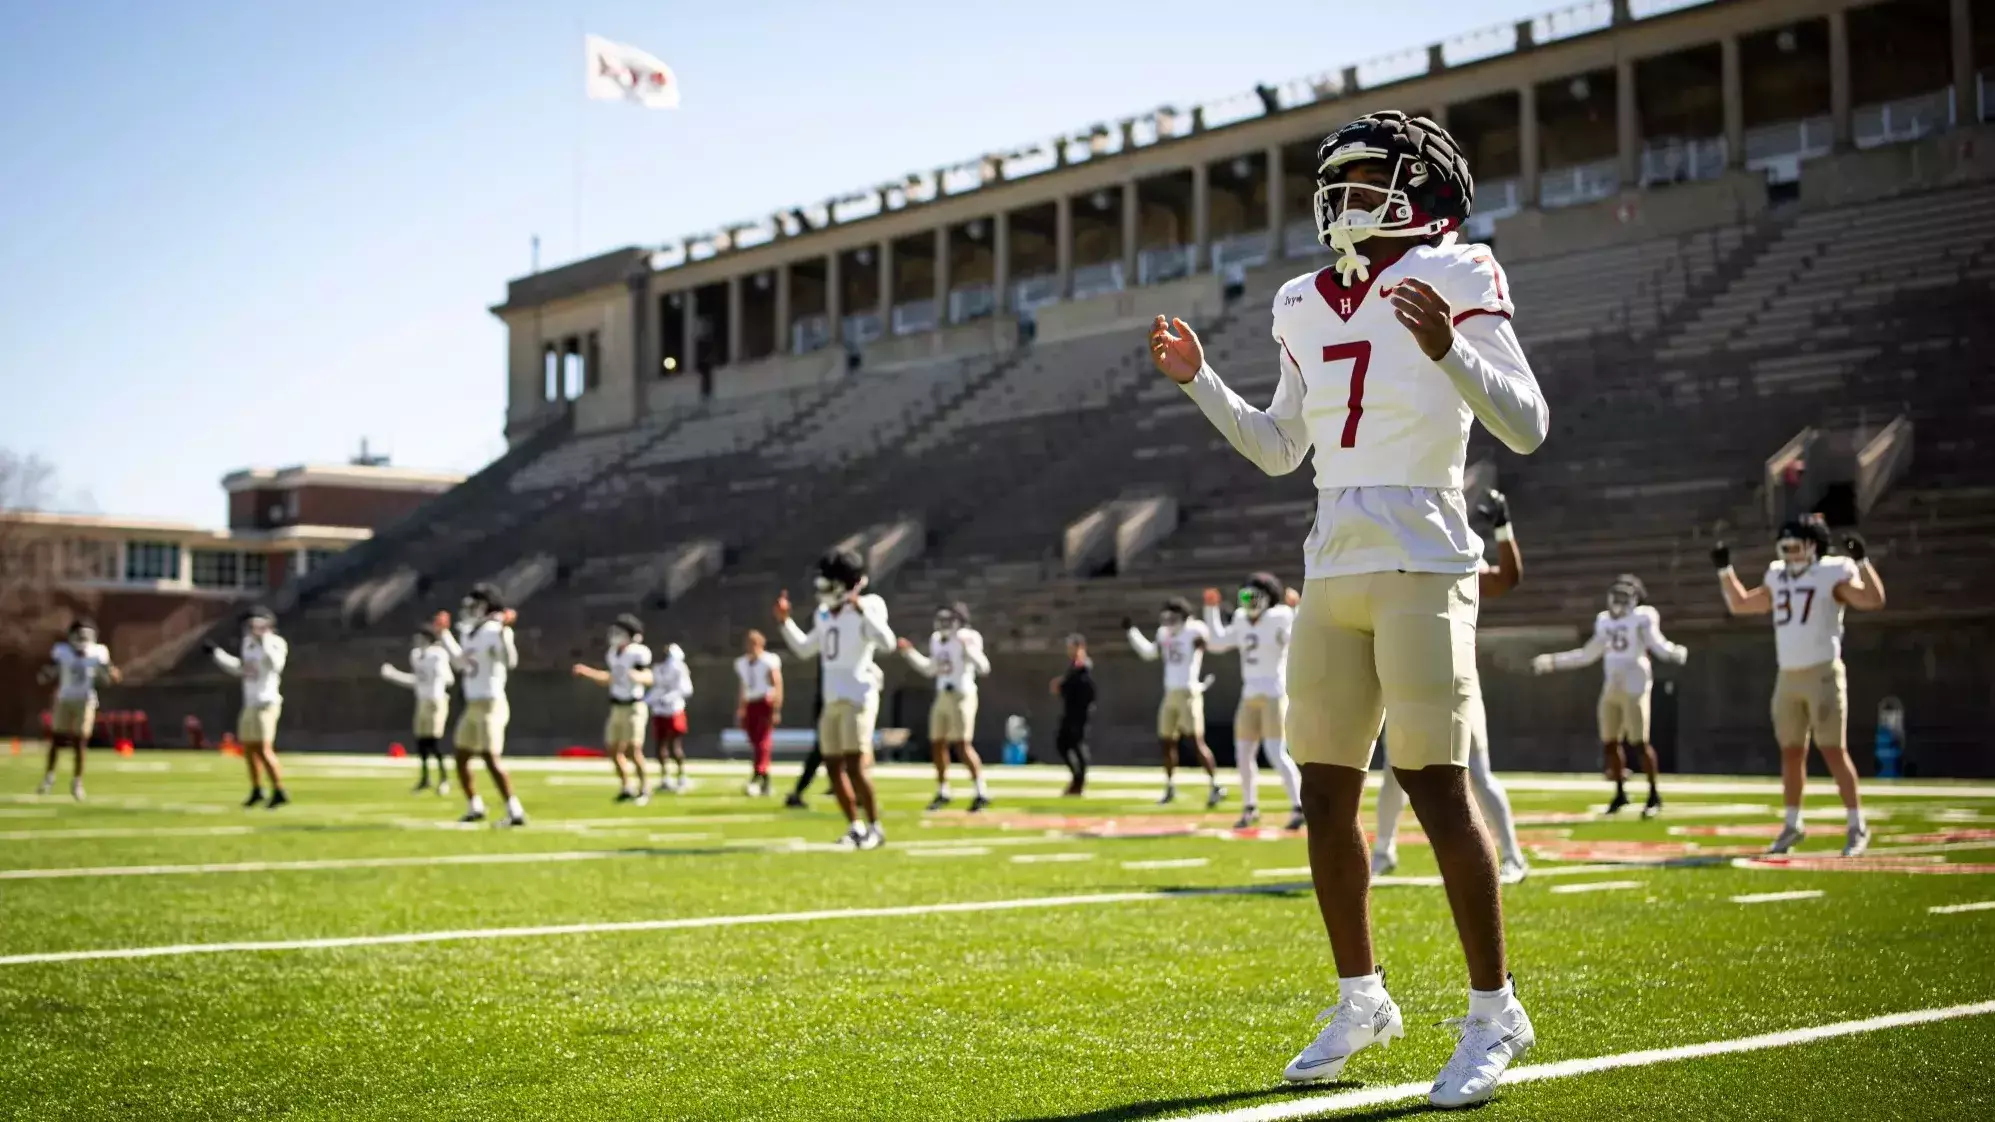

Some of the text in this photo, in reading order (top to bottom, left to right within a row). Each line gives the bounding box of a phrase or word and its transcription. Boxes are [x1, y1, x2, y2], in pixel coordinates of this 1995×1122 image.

[1340, 297, 1352, 315] H
[1323, 340, 1372, 448] 7
[1776, 588, 1816, 625] 37
